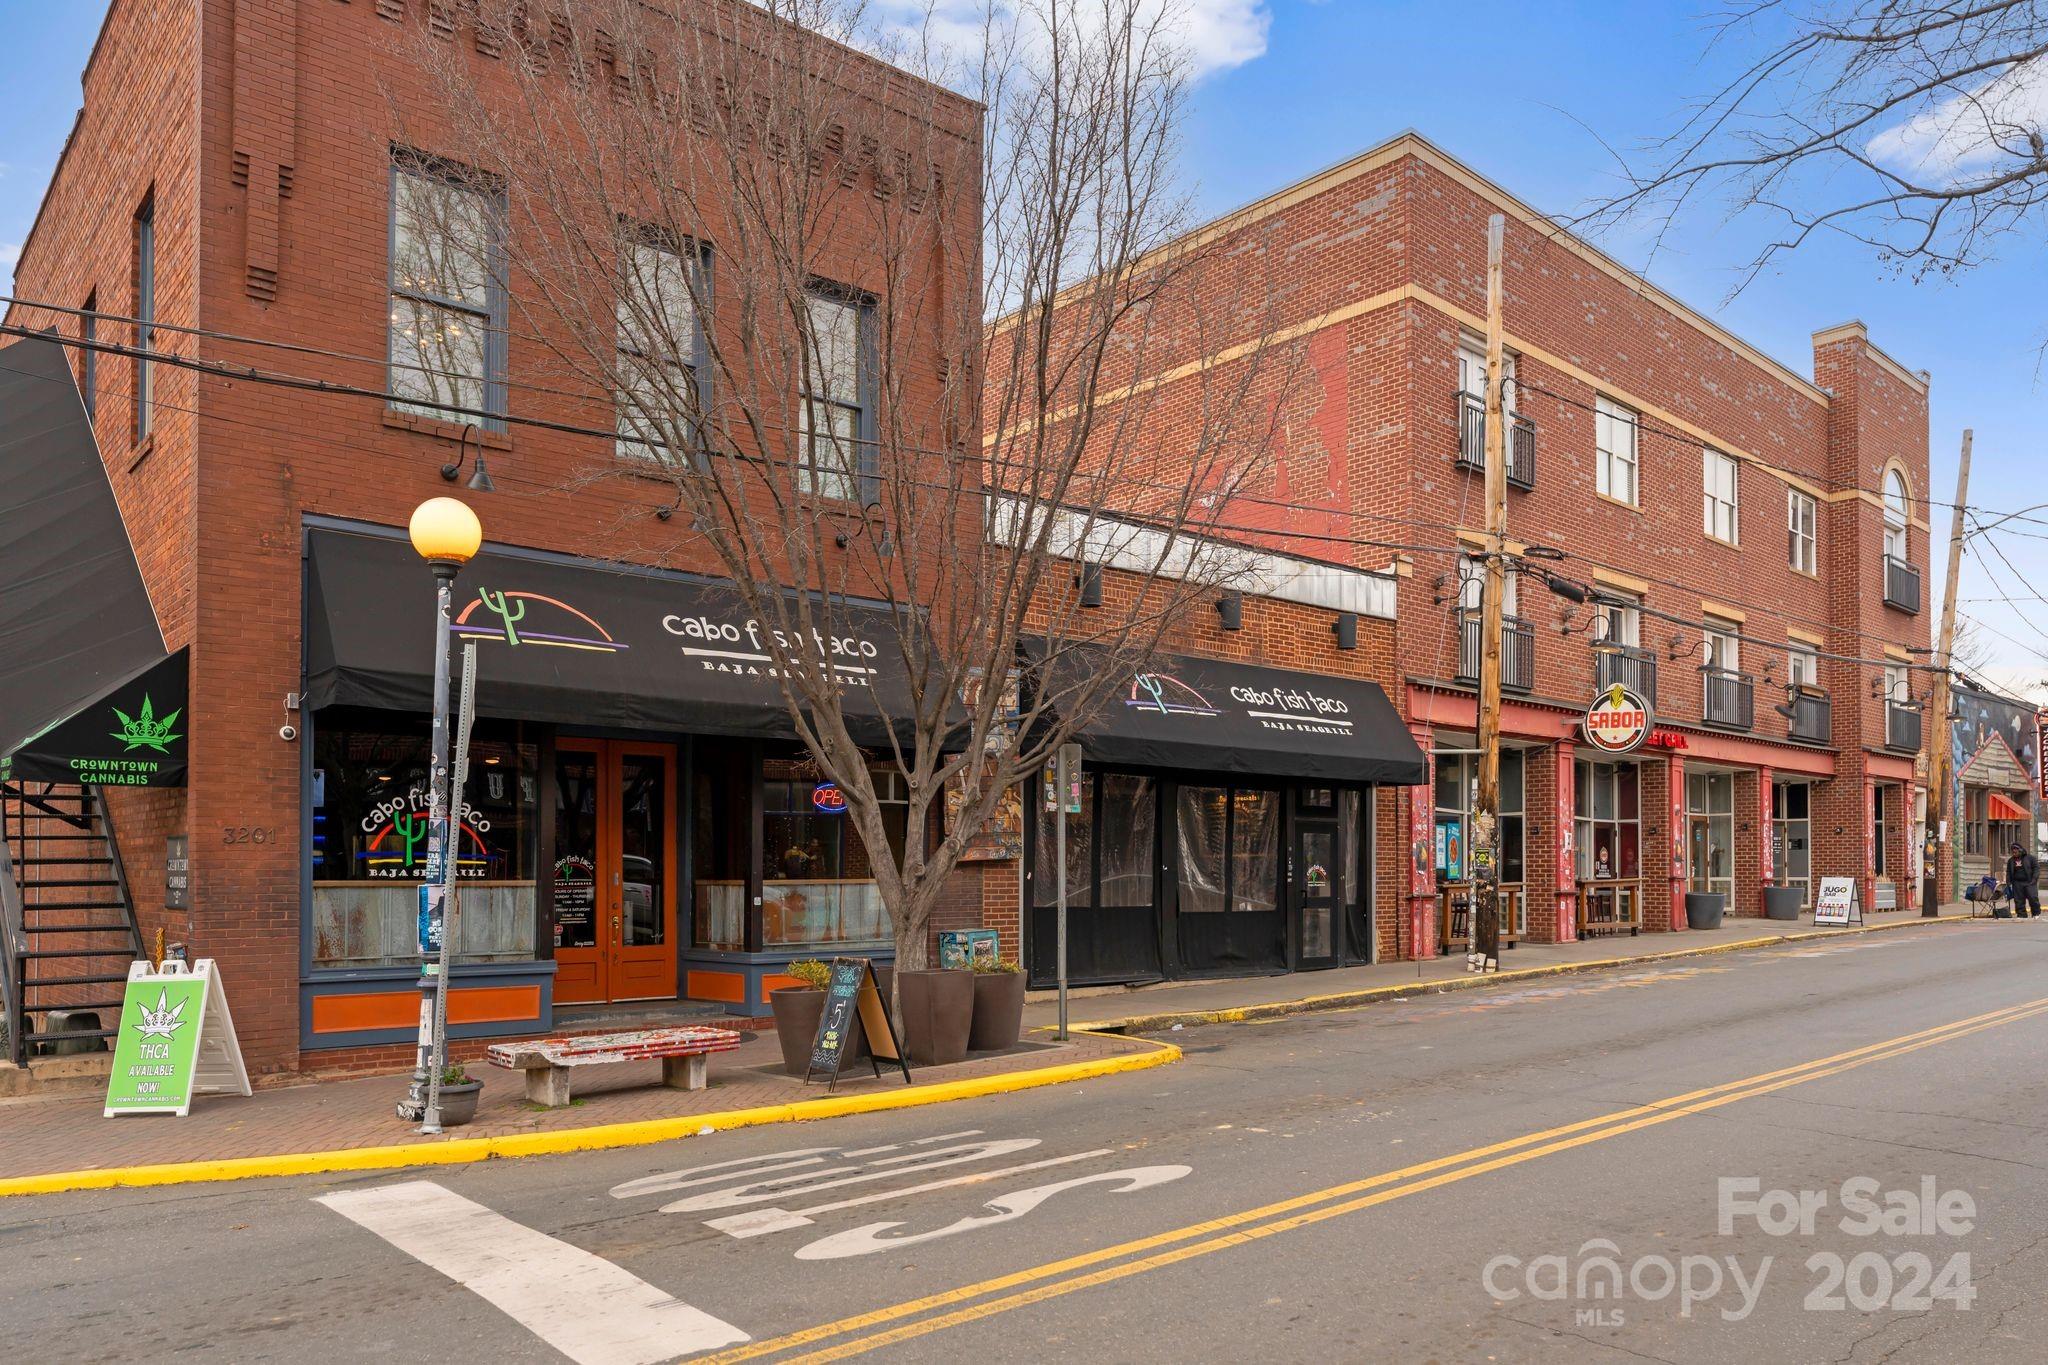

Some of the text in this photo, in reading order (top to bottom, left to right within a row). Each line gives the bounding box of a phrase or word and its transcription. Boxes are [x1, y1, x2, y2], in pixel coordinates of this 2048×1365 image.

[662, 614, 877, 657] cabo fs taco
[701, 661, 870, 686] BAJA SEILL
[1230, 686, 1348, 713] cabo fish taco
[1588, 711, 1645, 728] SABOR
[1261, 721, 1353, 736] BAJA SEAGRILL
[70, 759, 158, 772] CROWNTOWN
[79, 773, 148, 785] CANNABIS
[813, 789, 843, 805] OPE
[361, 788, 491, 832] cabo fis aco
[223, 827, 277, 845] 3201
[369, 868, 486, 878] BAJA SEILL
[140, 1043, 169, 1059] THCA
[128, 1065, 175, 1077] AVAILABLE
[137, 1081, 161, 1093] NOW!
